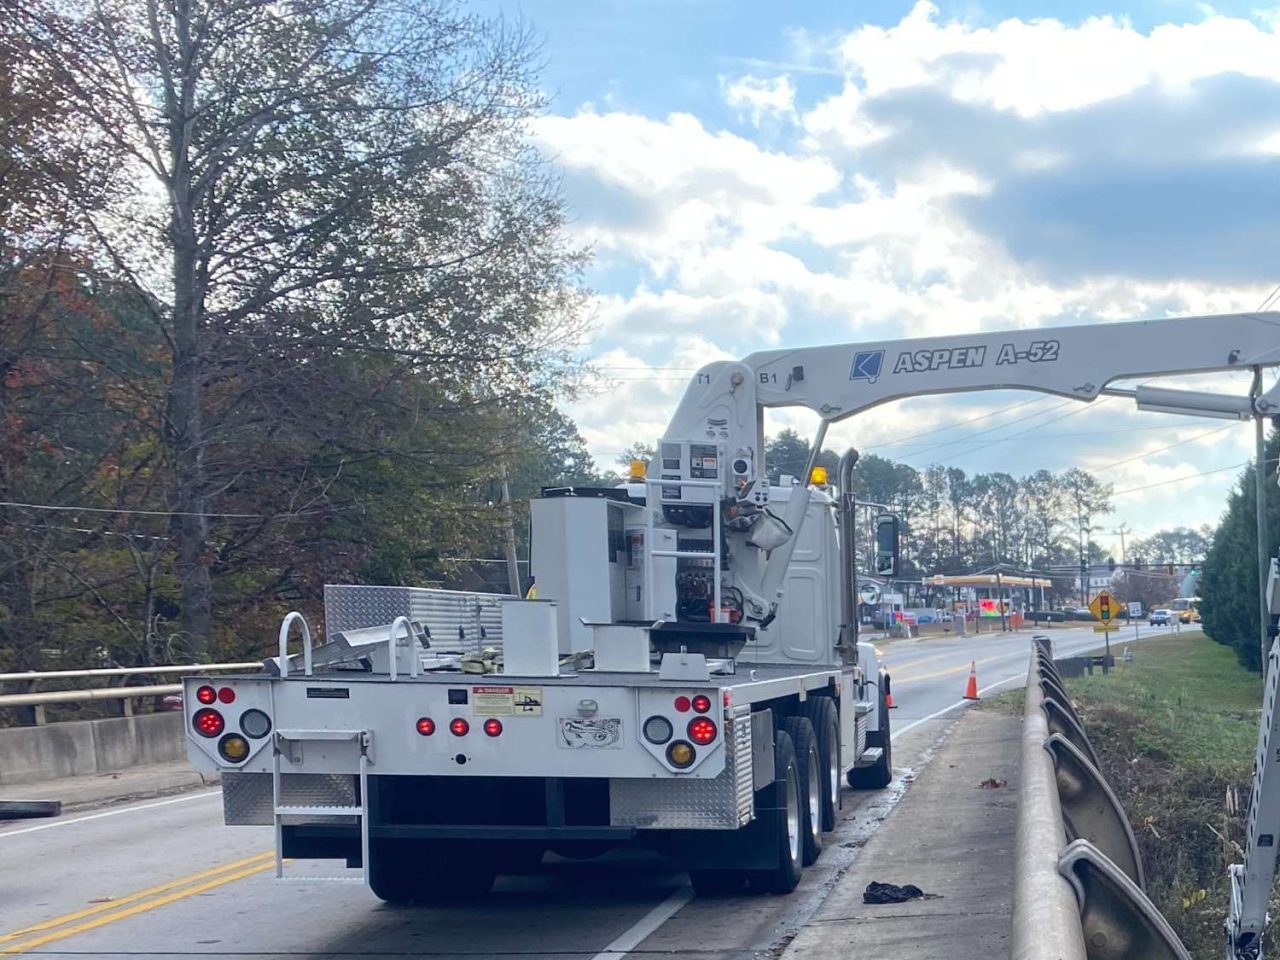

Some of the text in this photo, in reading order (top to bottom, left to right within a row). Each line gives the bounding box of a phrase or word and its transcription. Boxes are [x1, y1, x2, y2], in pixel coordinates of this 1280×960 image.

[893, 340, 1060, 374] ASPEN A-52
[697, 374, 710, 385] T1
[760, 373, 777, 384] B1
